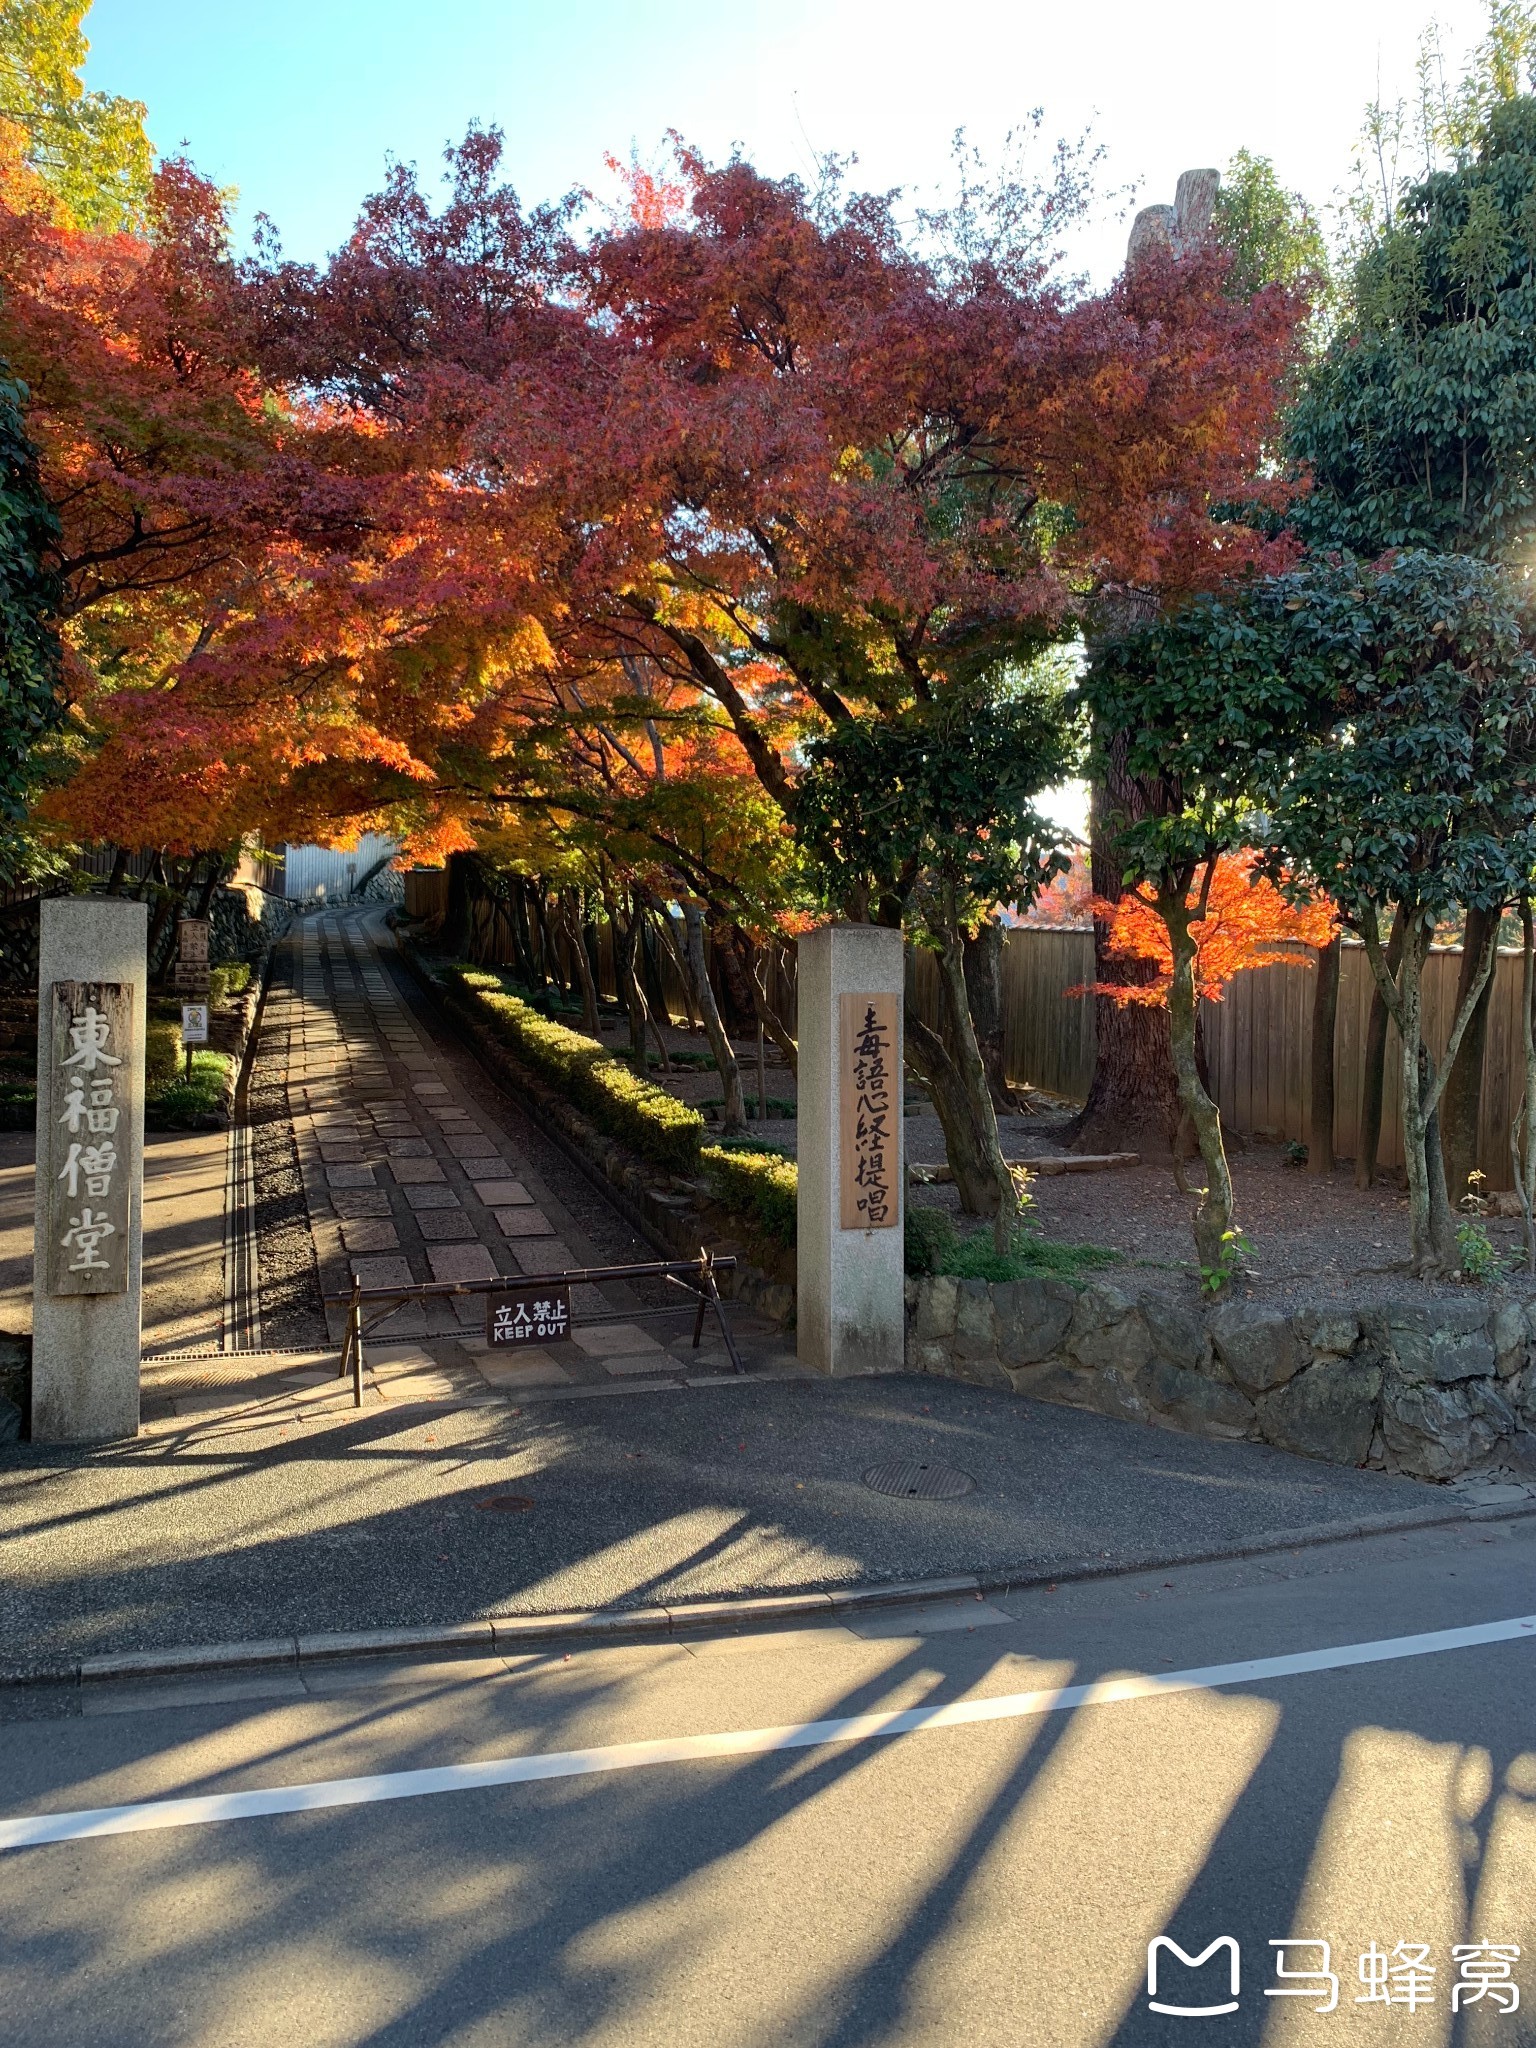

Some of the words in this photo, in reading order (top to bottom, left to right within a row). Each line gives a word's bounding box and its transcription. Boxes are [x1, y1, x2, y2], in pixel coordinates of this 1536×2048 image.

[58, 1007, 122, 1272] 東福僧堂
[853, 1007, 890, 1222] 毒語心経提唱
[493, 1299, 568, 1327] 立入禁止
[494, 1324, 533, 1341] KEEP
[537, 1322, 567, 1336] OUT
